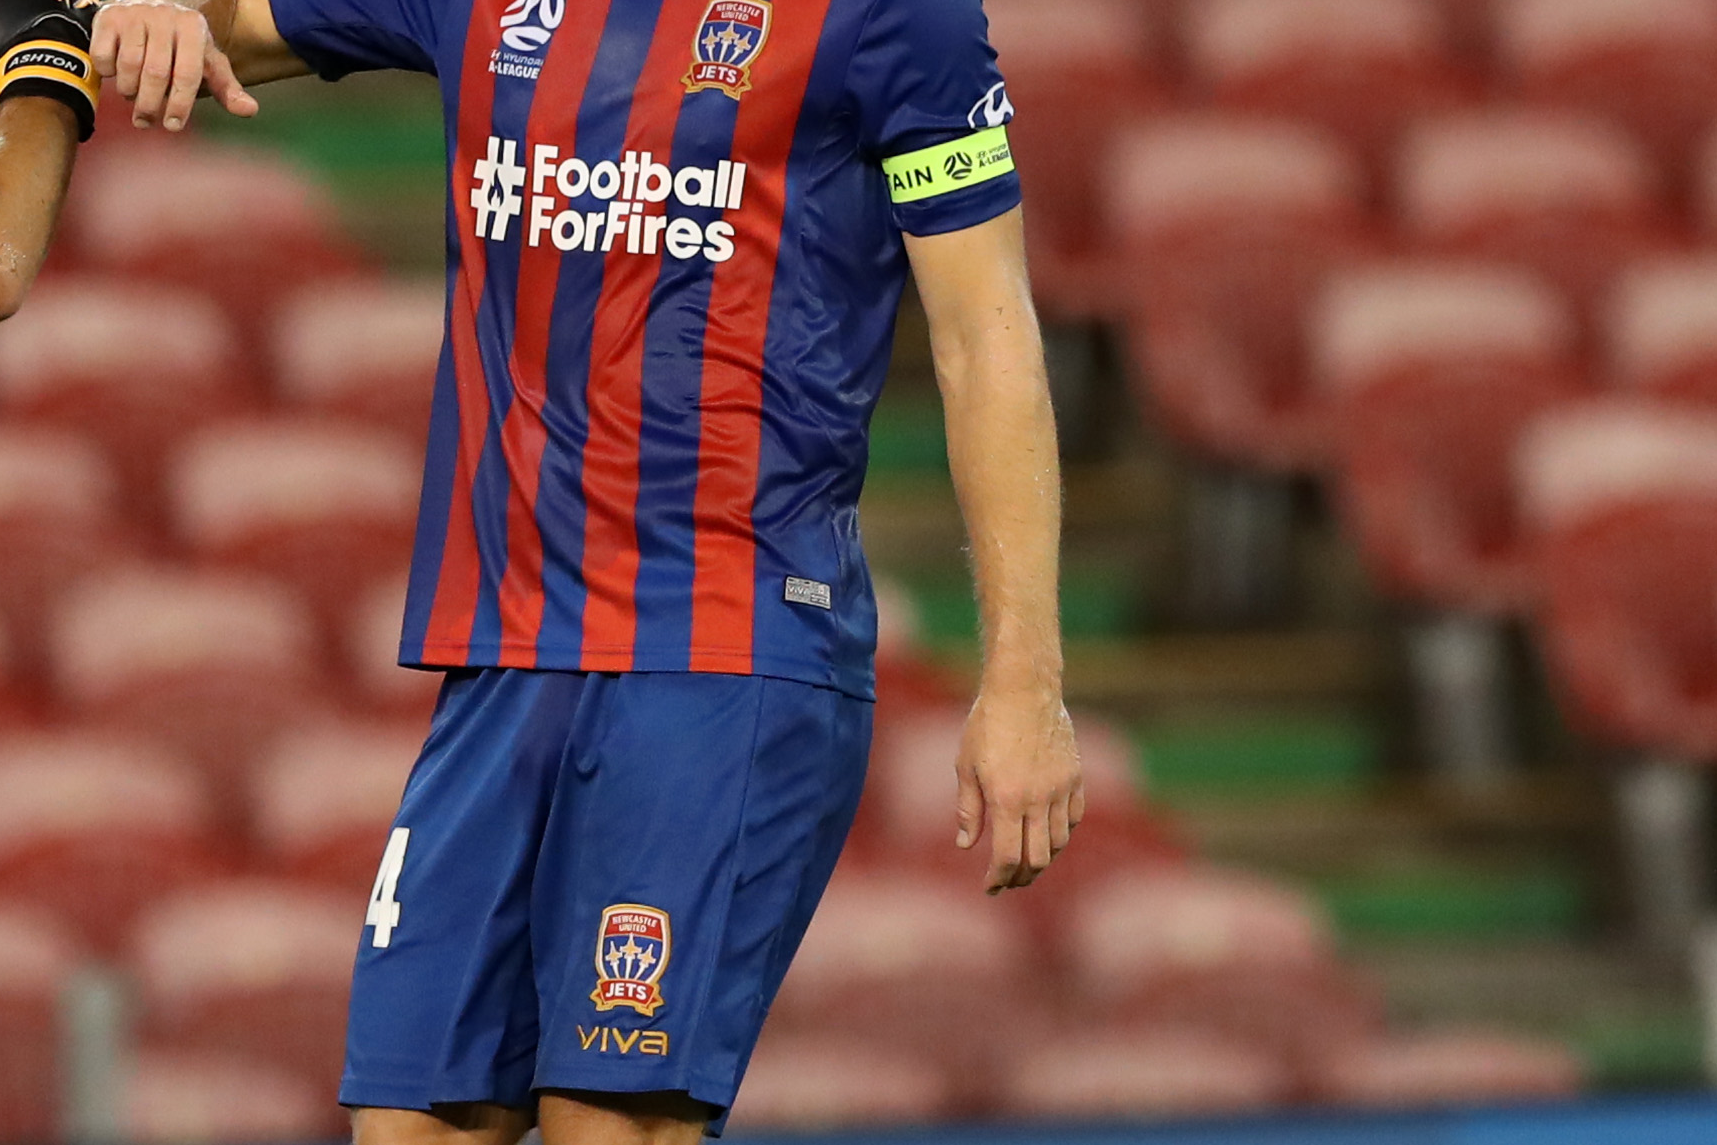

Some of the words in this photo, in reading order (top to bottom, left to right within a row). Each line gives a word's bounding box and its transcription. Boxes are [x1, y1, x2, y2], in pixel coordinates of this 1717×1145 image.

[716, 3, 761, 18] NEWCASTLE
[7, 53, 78, 72] ASHTON
[488, 60, 541, 80] A-LEAGUE
[696, 65, 738, 84] JETS
[886, 165, 934, 191] AIN
[528, 195, 735, 262] ForFires
[364, 826, 411, 948] 4
[612, 914, 659, 928] NEWCASTLE
[618, 923, 647, 934] UNITED
[605, 982, 648, 1001] JETS
